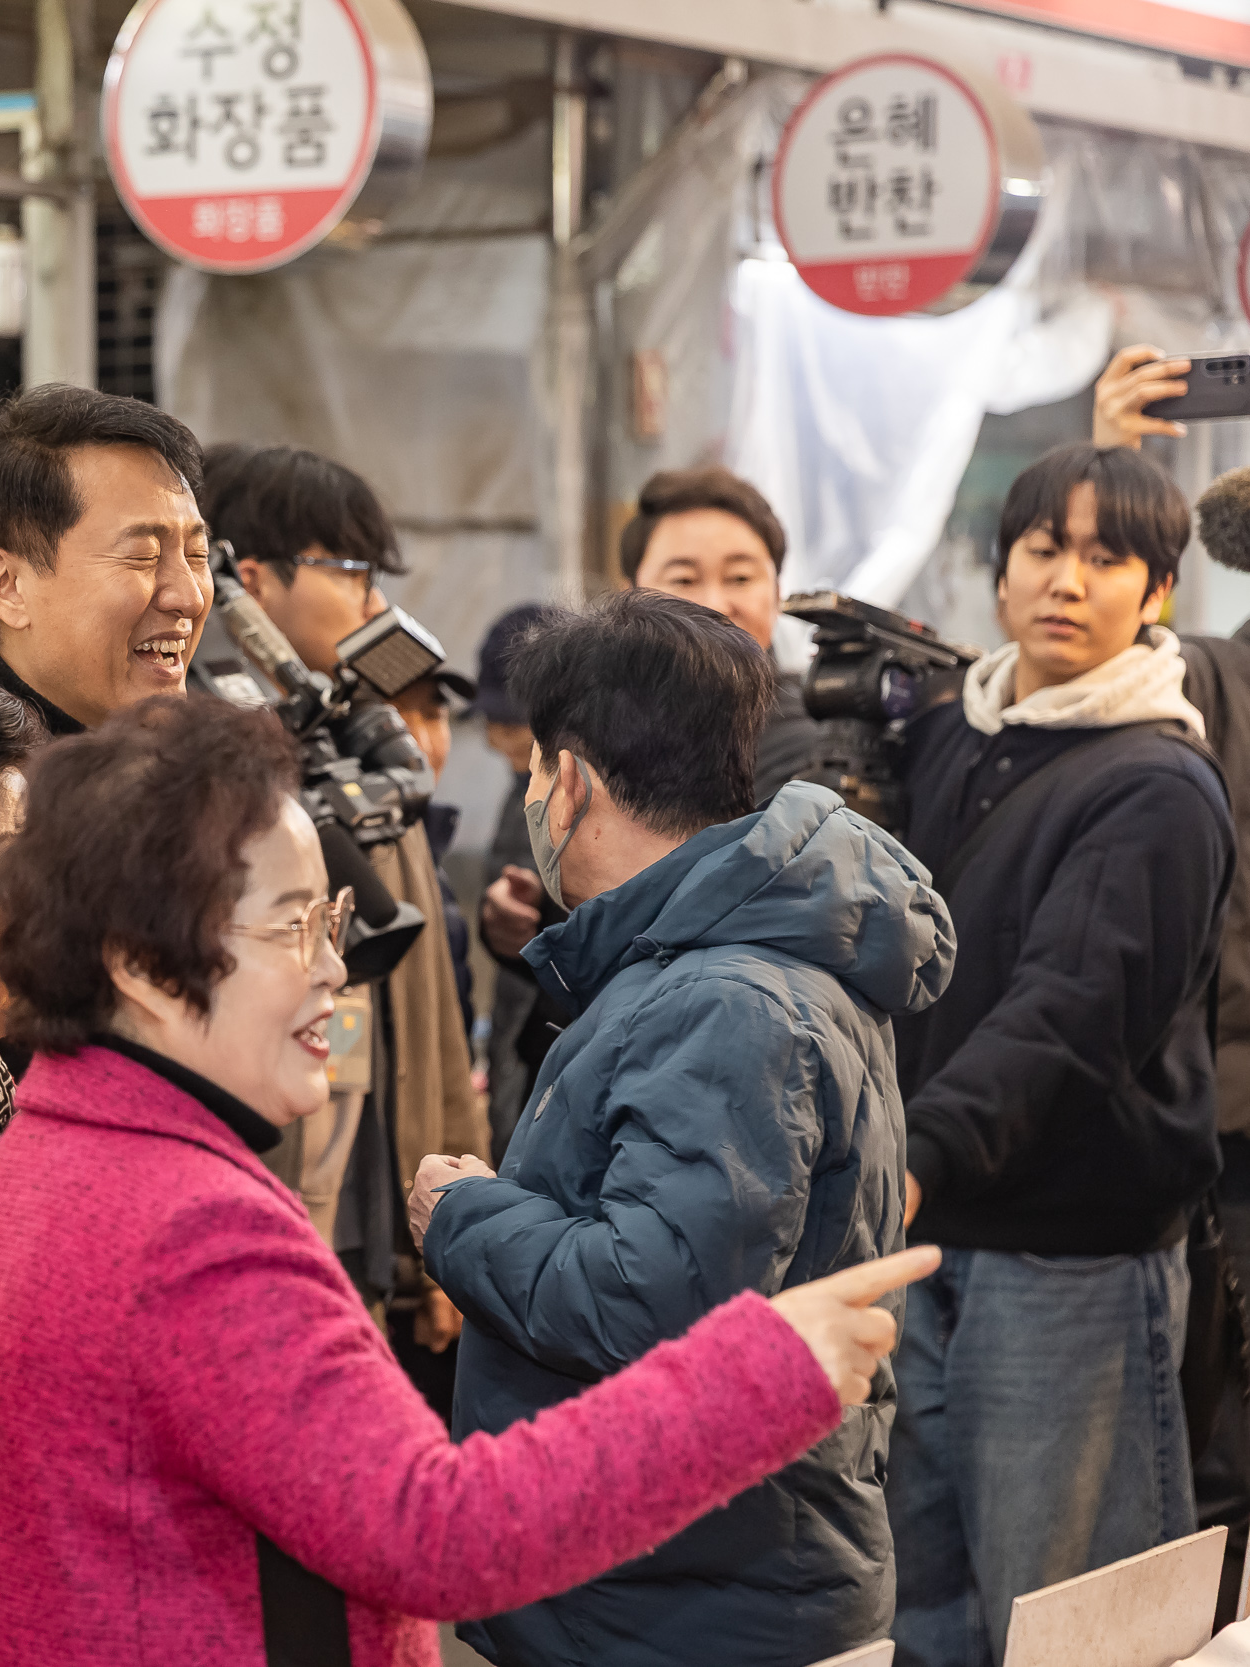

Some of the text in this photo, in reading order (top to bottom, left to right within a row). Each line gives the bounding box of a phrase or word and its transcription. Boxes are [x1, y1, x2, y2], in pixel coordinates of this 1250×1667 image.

[180, 0, 306, 81] 수정
[142, 82, 336, 170] 화장품
[828, 92, 938, 168] 은혜
[826, 164, 940, 241] 반찬
